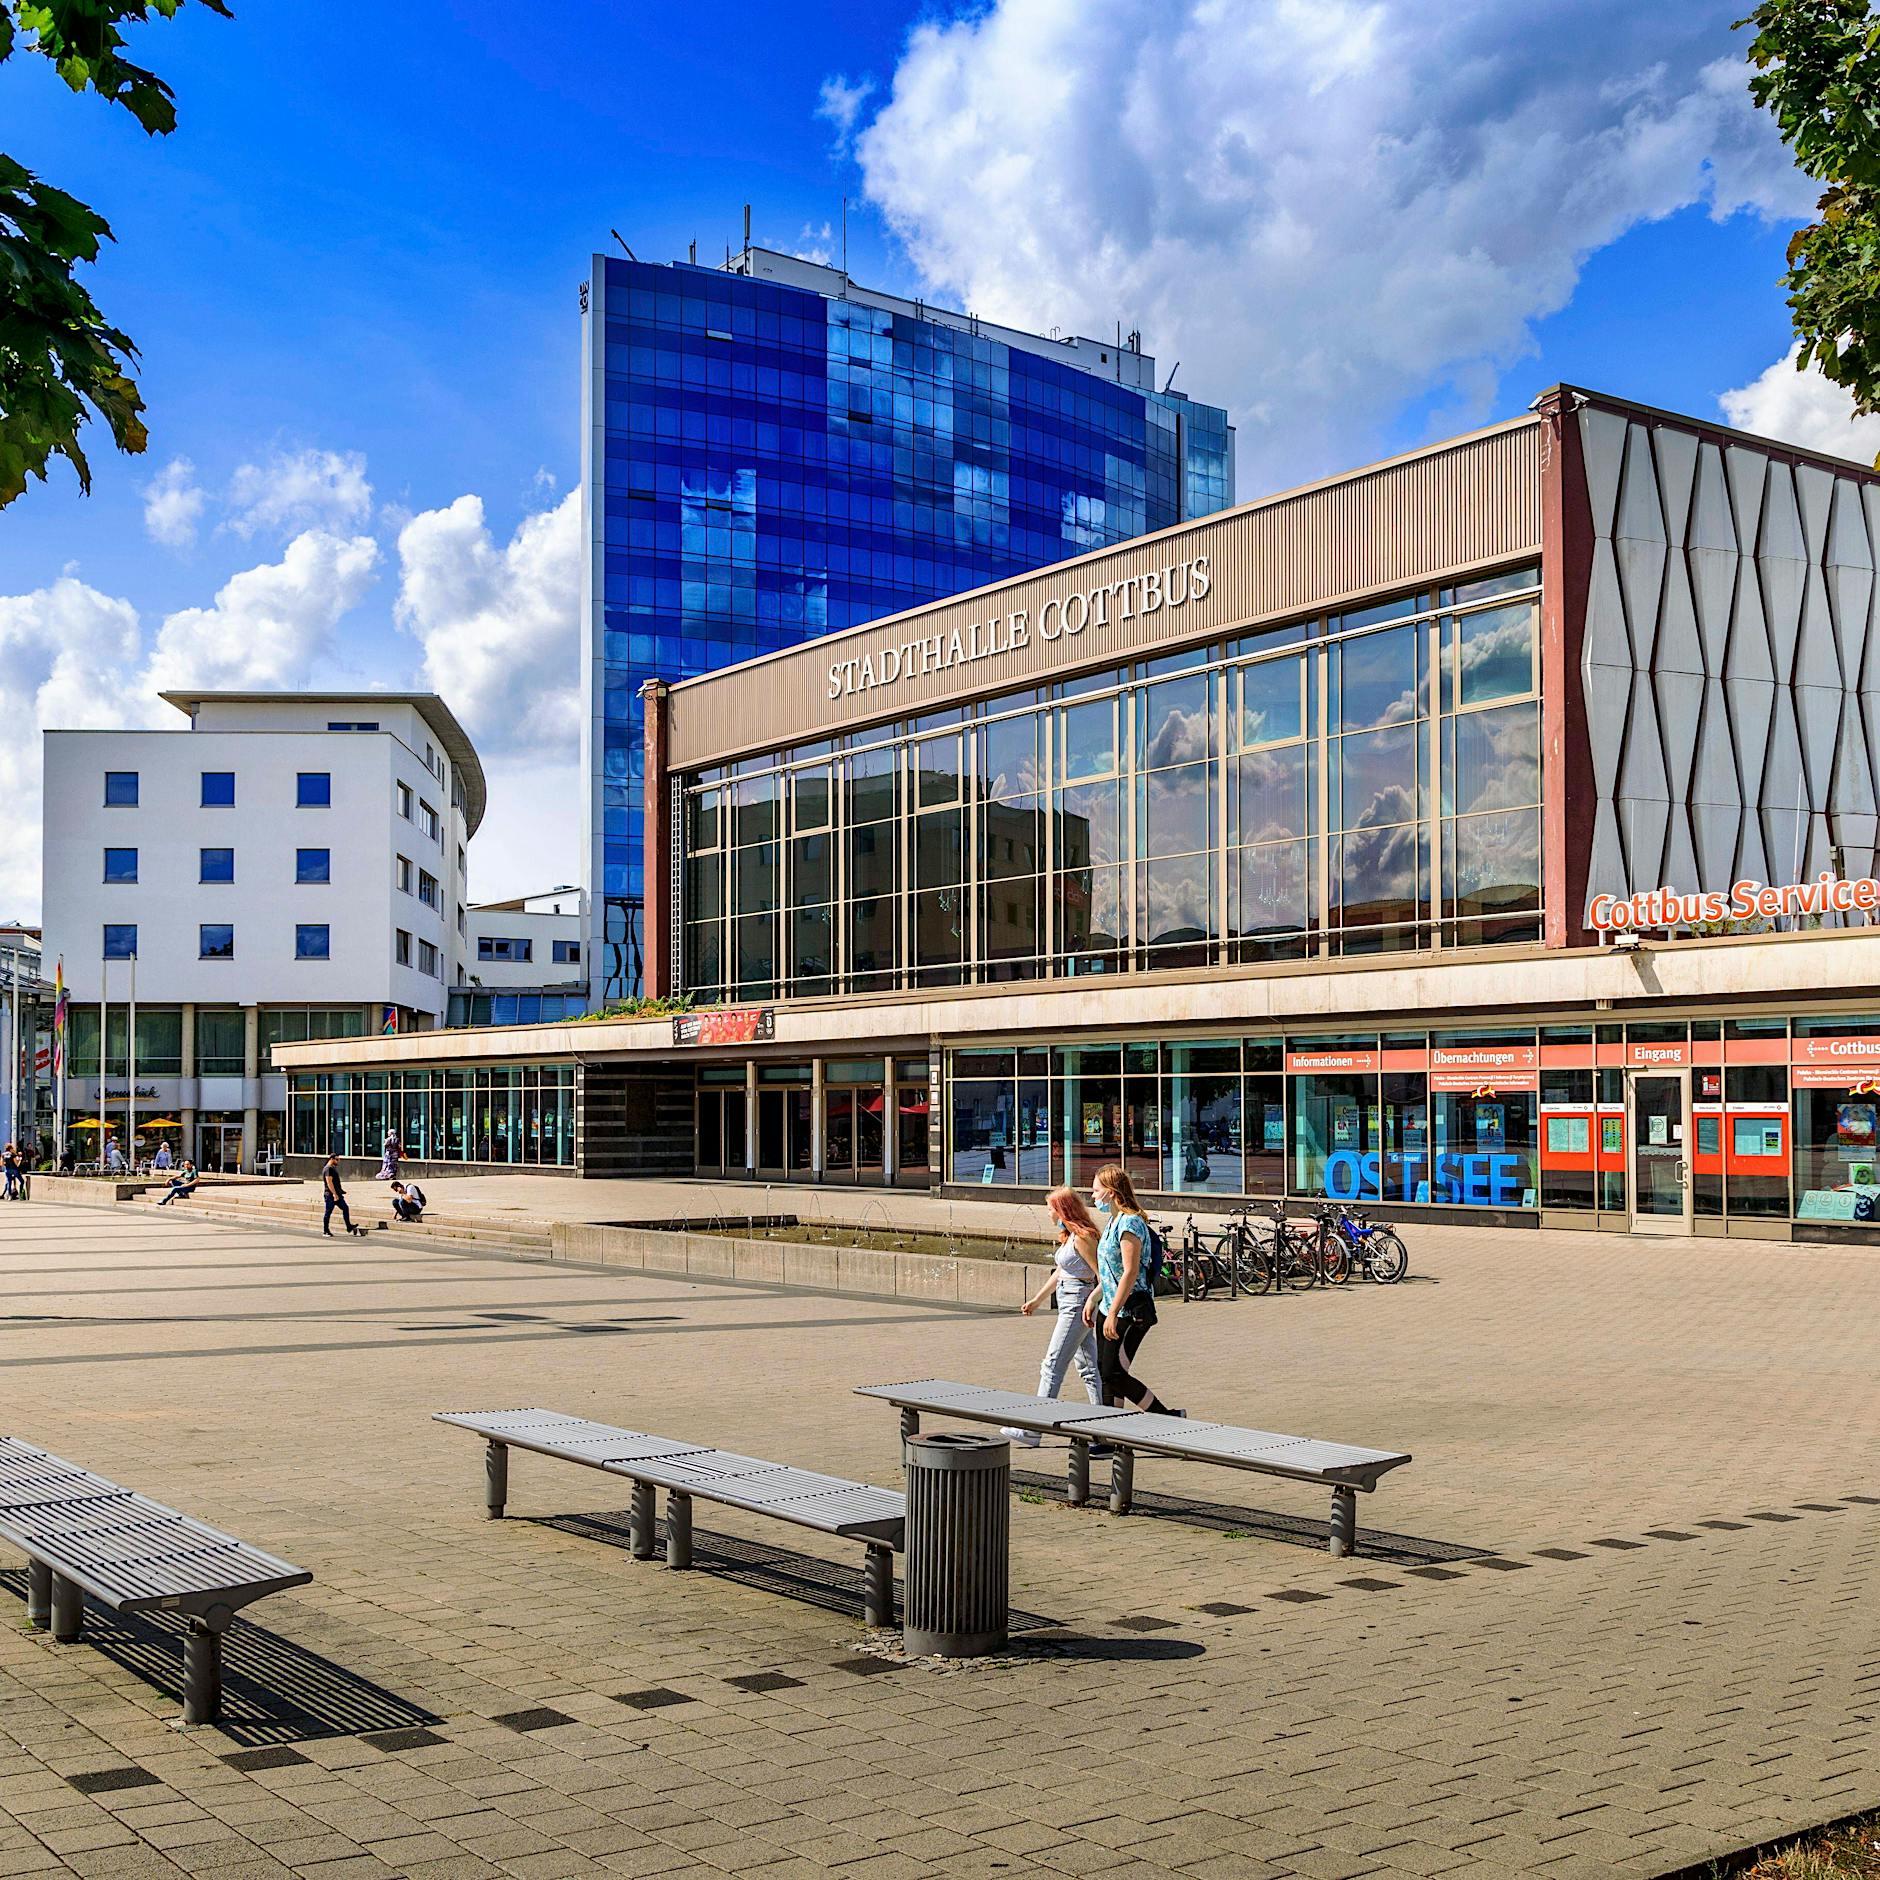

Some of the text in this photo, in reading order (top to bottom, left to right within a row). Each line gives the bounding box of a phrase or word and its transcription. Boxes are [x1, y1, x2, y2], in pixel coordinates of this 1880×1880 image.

[828, 556, 1211, 700] STADTHALLE COTTBUS
[1590, 871, 1877, 931] Cottbus Service
[1292, 1055, 1353, 1067] Informationen
[1433, 1050, 1514, 1066] Übernachtungen
[1634, 1046, 1682, 1062] Eingang
